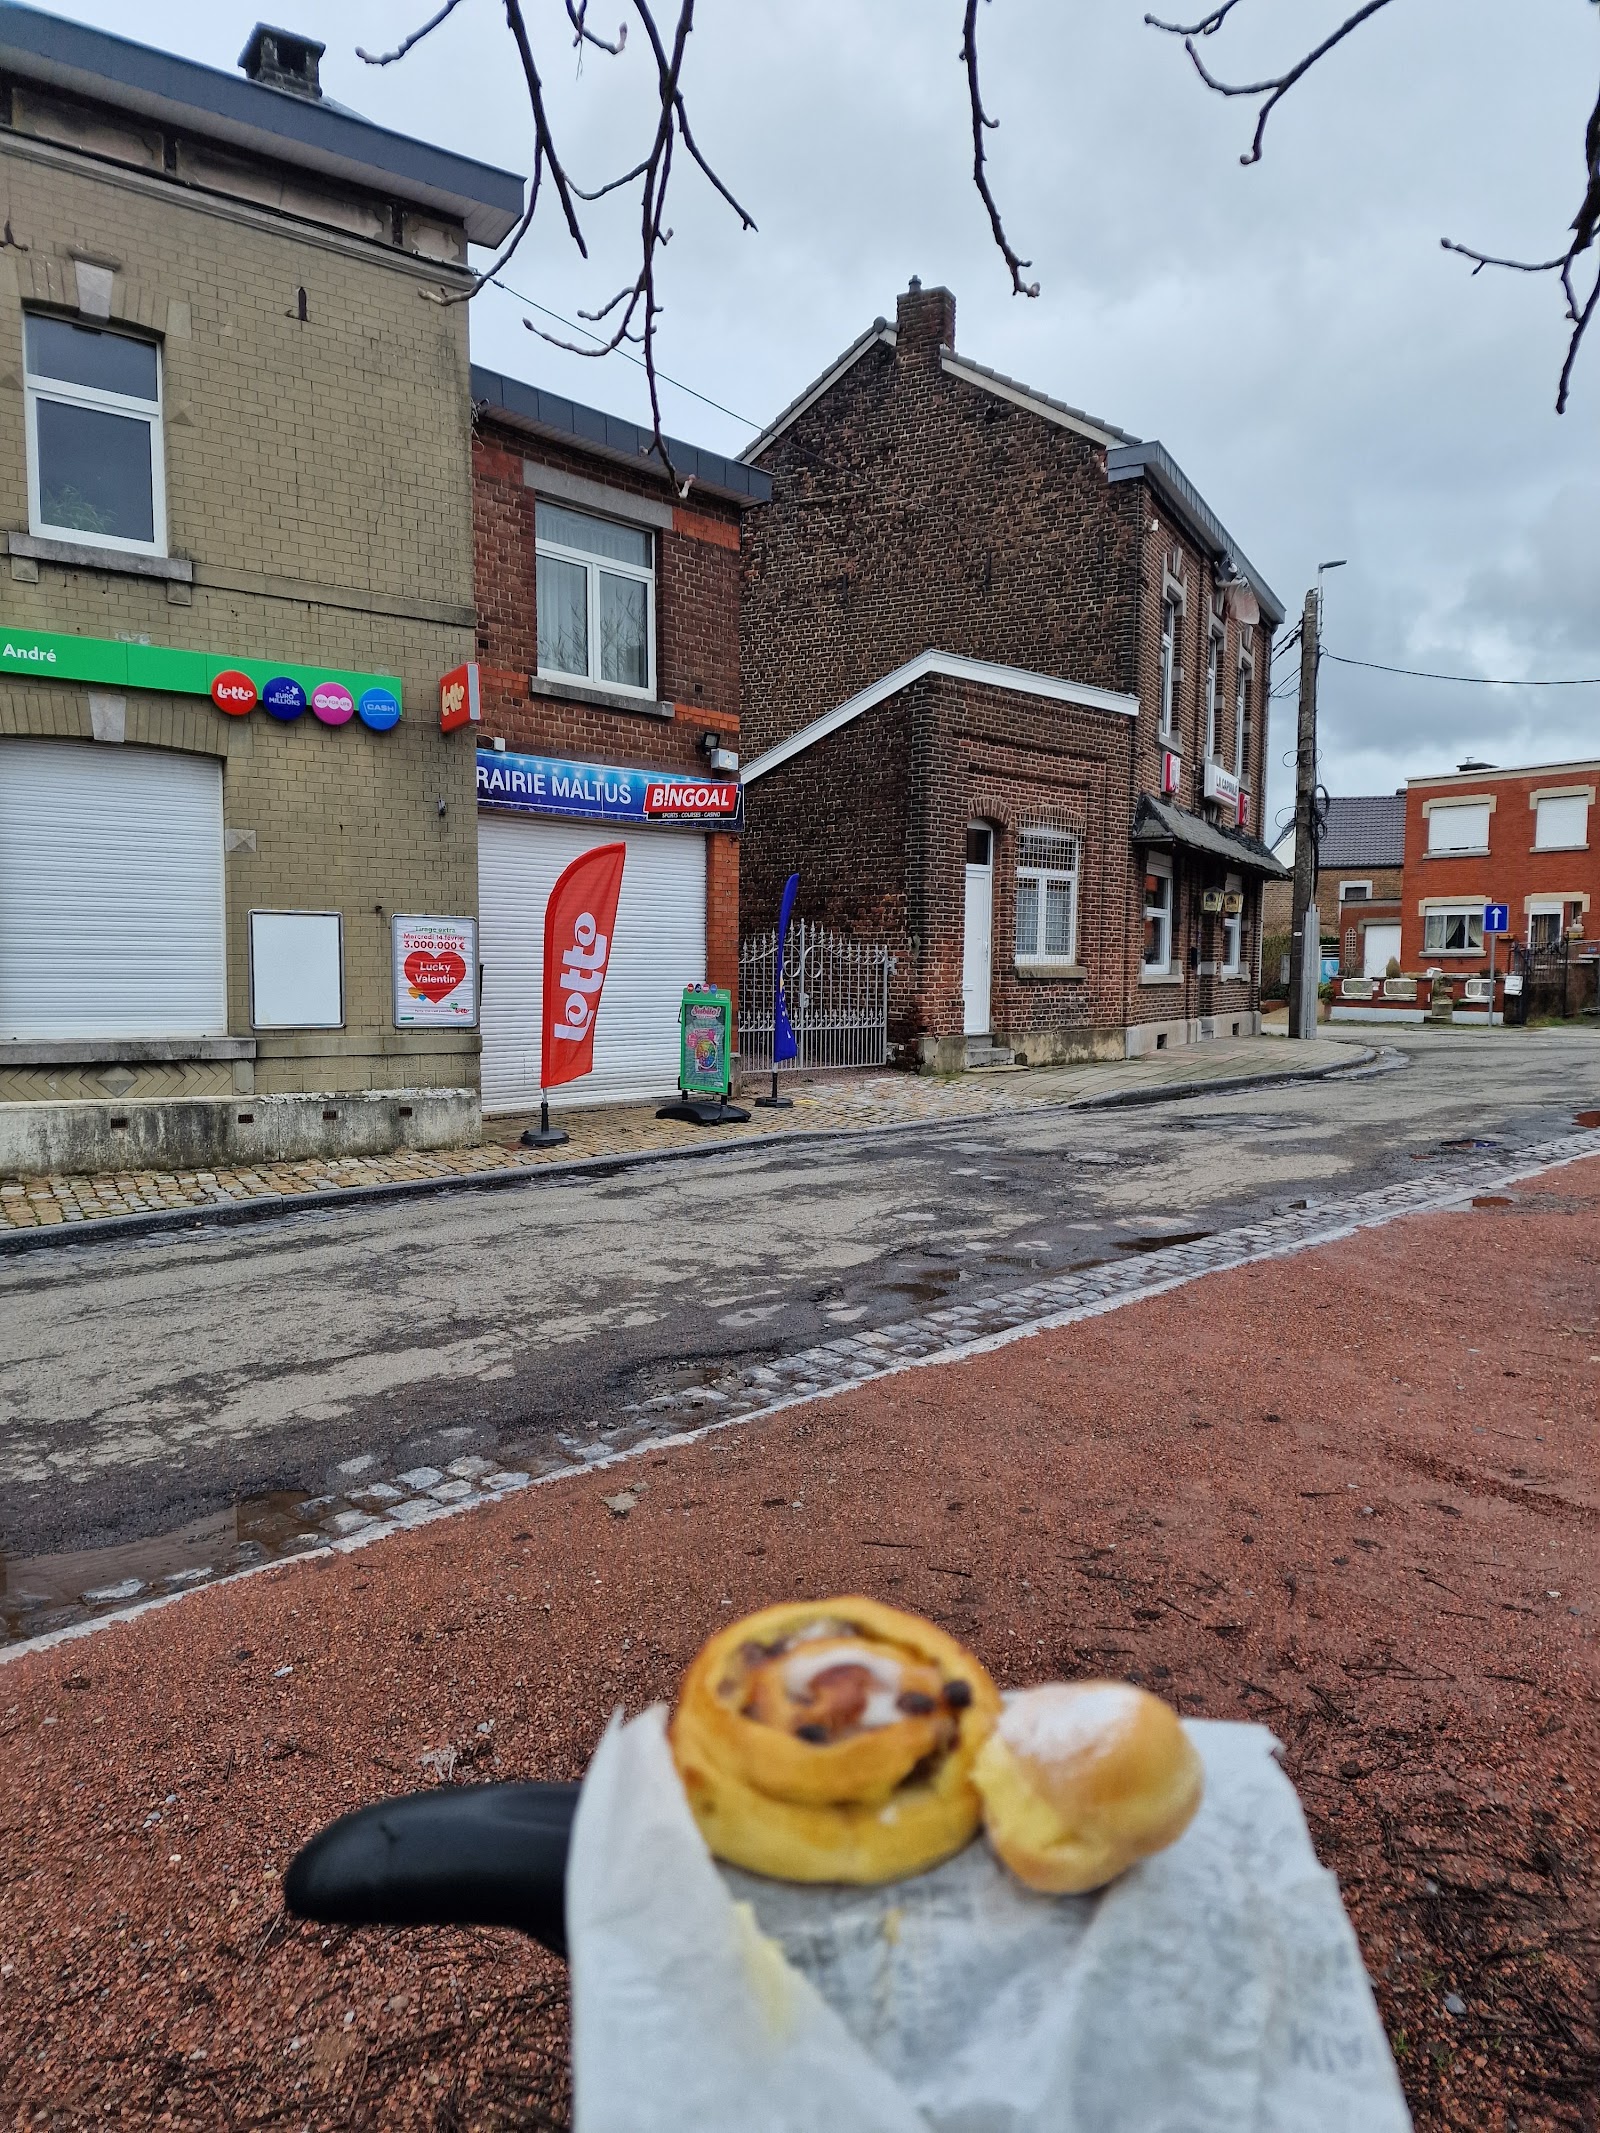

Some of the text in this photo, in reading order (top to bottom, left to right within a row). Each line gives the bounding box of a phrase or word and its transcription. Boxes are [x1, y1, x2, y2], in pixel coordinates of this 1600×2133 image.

[3, 643, 56, 662] André
[275, 692, 294, 700] EURO
[269, 697, 300, 706] MILLIONS
[367, 704, 394, 712] CASH
[552, 775, 632, 804] MALTUS
[403, 933, 434, 941] Mercredi
[404, 940, 466, 950] 3.000.000 €
[420, 962, 451, 973] Lucky
[415, 974, 456, 984] Valentin
